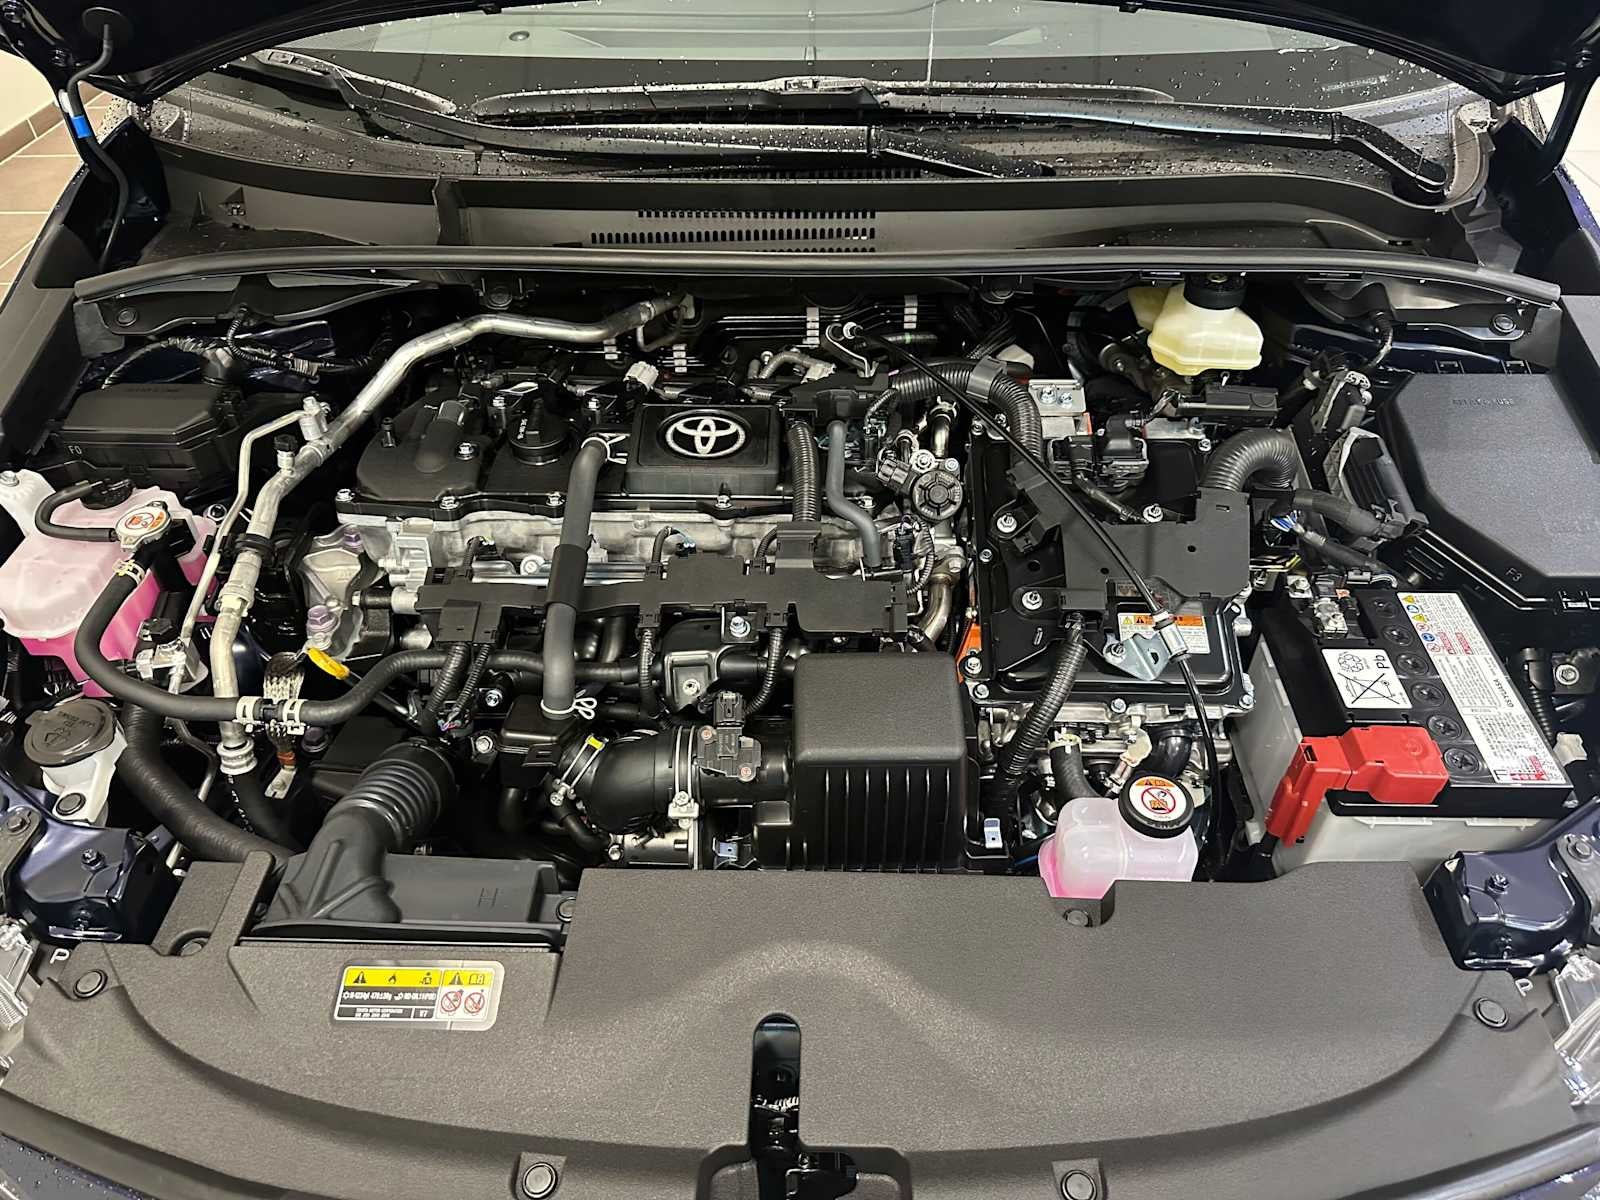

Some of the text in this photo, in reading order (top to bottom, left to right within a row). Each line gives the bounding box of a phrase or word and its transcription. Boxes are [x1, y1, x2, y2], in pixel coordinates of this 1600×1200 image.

[1505, 567, 1523, 582] F3
[1374, 654, 1391, 669] Pb
[49, 948, 70, 964] P
[1515, 978, 1533, 997] P
